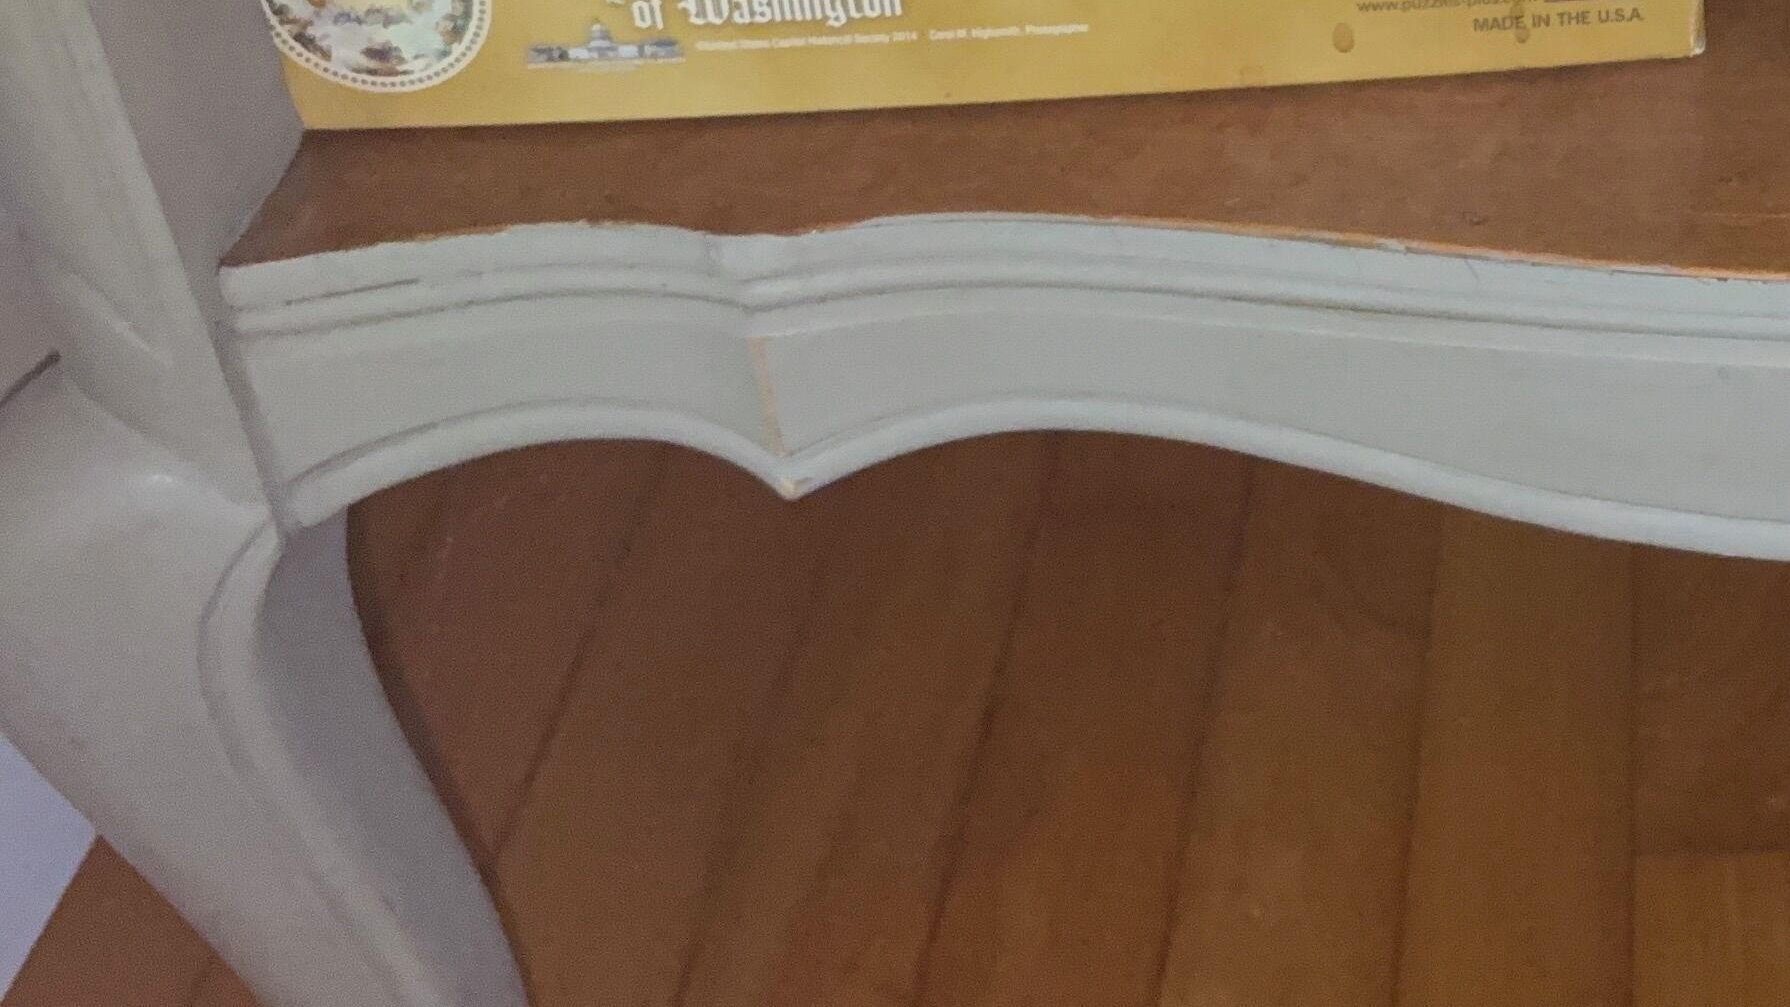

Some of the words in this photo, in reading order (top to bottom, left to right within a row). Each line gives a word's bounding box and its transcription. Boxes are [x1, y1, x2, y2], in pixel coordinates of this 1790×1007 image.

[1474, 15, 1525, 32] MADE
[1532, 14, 1550, 28] IN
[1558, 11, 1591, 26] THE
